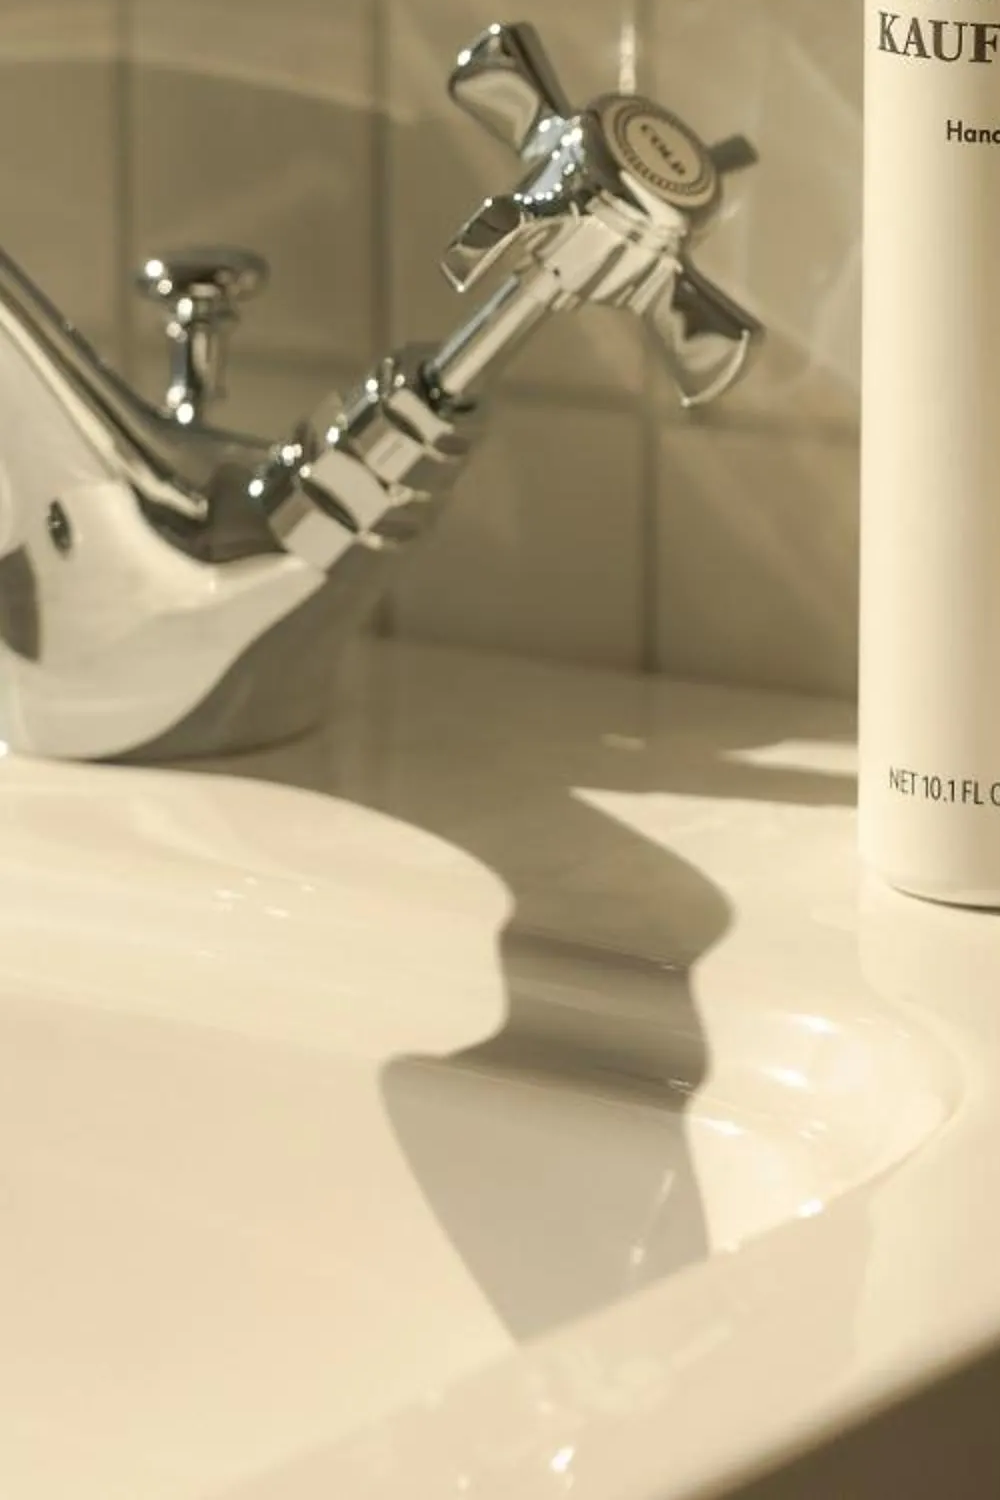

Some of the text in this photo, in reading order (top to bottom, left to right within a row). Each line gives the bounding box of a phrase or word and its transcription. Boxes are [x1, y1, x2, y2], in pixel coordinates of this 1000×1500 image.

[889, 766, 919, 796] NET
[922, 774, 956, 804] 10.1
[962, 779, 985, 806] FL
